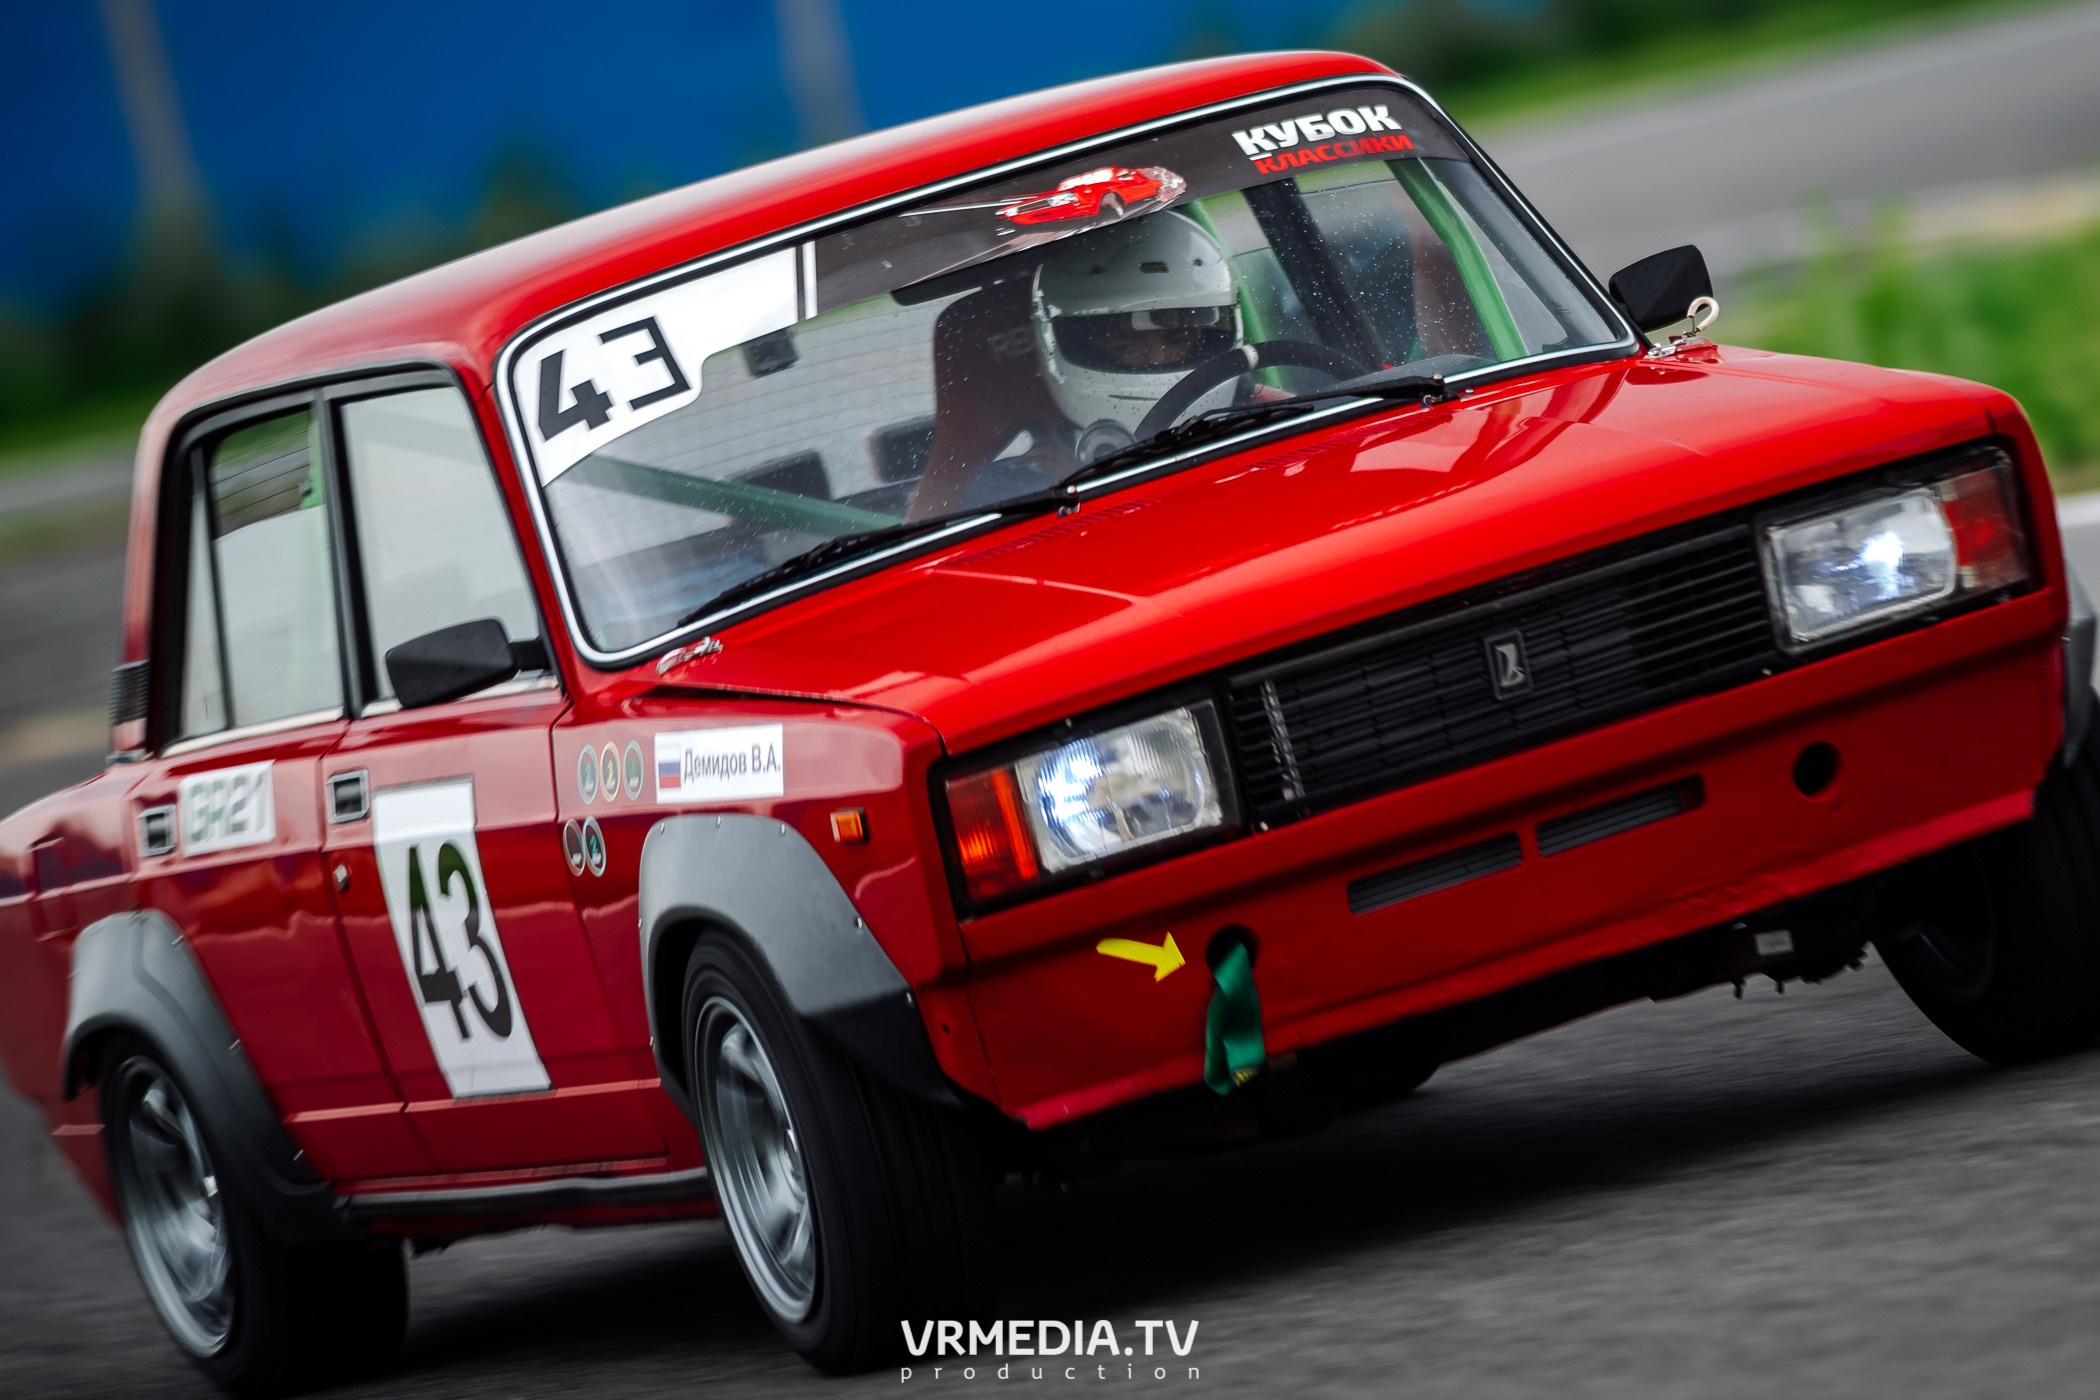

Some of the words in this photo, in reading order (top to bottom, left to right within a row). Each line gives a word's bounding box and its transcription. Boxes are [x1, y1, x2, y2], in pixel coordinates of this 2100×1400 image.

[1232, 104, 1402, 155] КУБОК
[1253, 134, 1415, 175] КЛАССИКИ
[538, 316, 692, 441] 43
[684, 748, 747, 784] Демидов
[752, 744, 781, 774] В.А.
[408, 839, 513, 1040] 43
